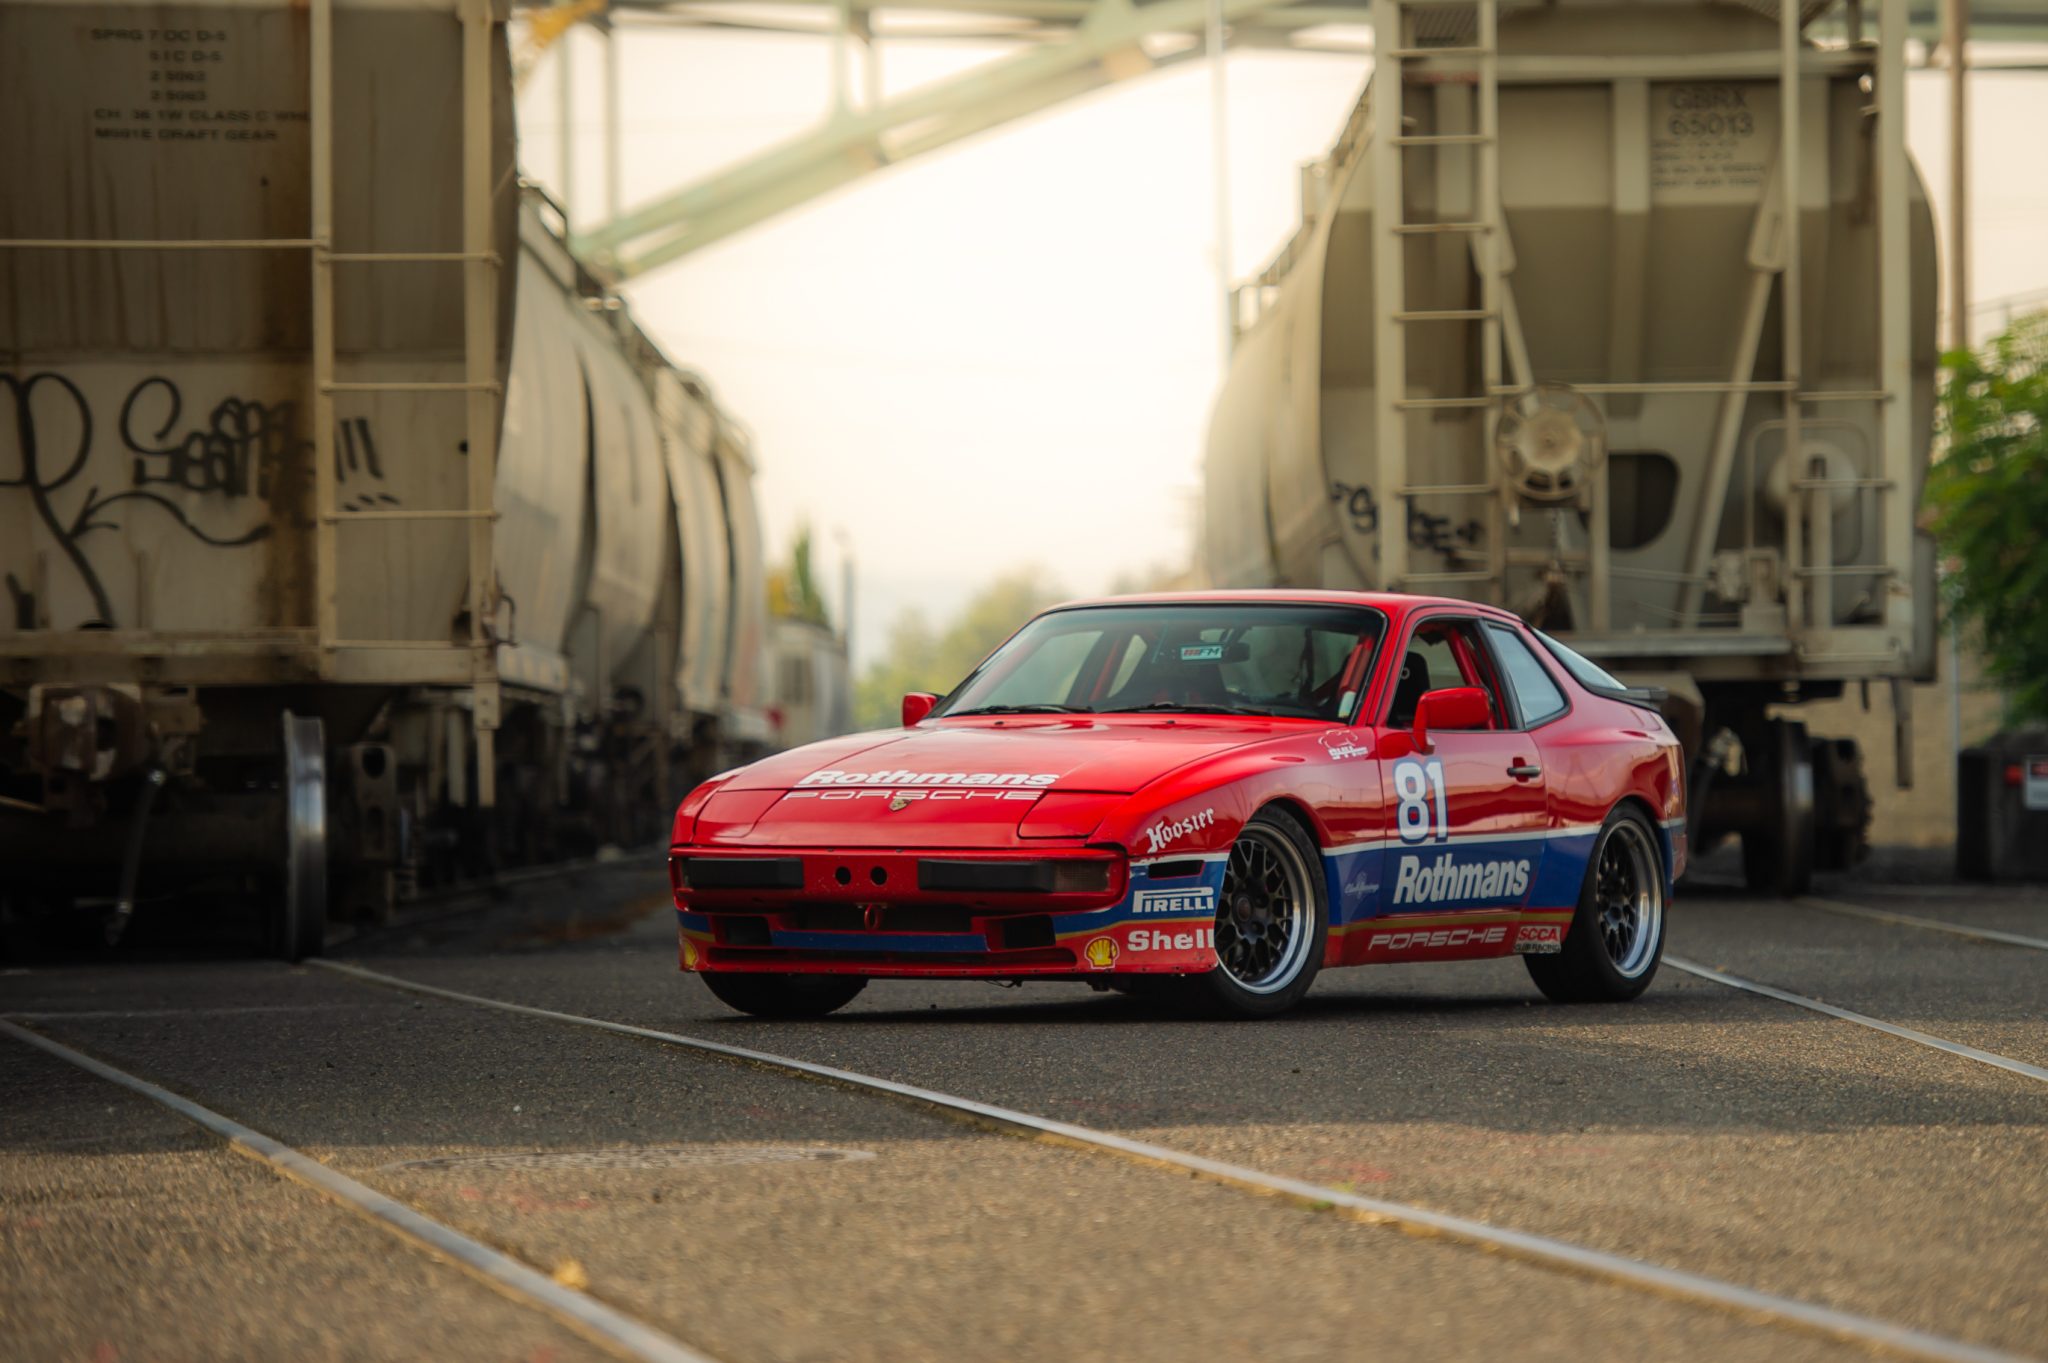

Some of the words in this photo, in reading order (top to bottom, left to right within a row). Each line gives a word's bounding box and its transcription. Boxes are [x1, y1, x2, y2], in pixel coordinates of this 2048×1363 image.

[189, 110, 249, 122] CLASS
[1668, 112, 1754, 137] 65013
[158, 129, 220, 141] DRAFT
[225, 129, 279, 141] GEAR
[797, 770, 1060, 786] Rothmans
[783, 790, 1043, 801] PORSCHE
[1393, 758, 1449, 845] 81
[1146, 808, 1215, 853] Hoosier
[1392, 853, 1530, 905] Rothmans
[1132, 887, 1215, 913] PIRELLI
[1127, 929, 1215, 951] Shell
[1368, 927, 1507, 950] PORSCHE
[1519, 927, 1558, 941] SCCA
